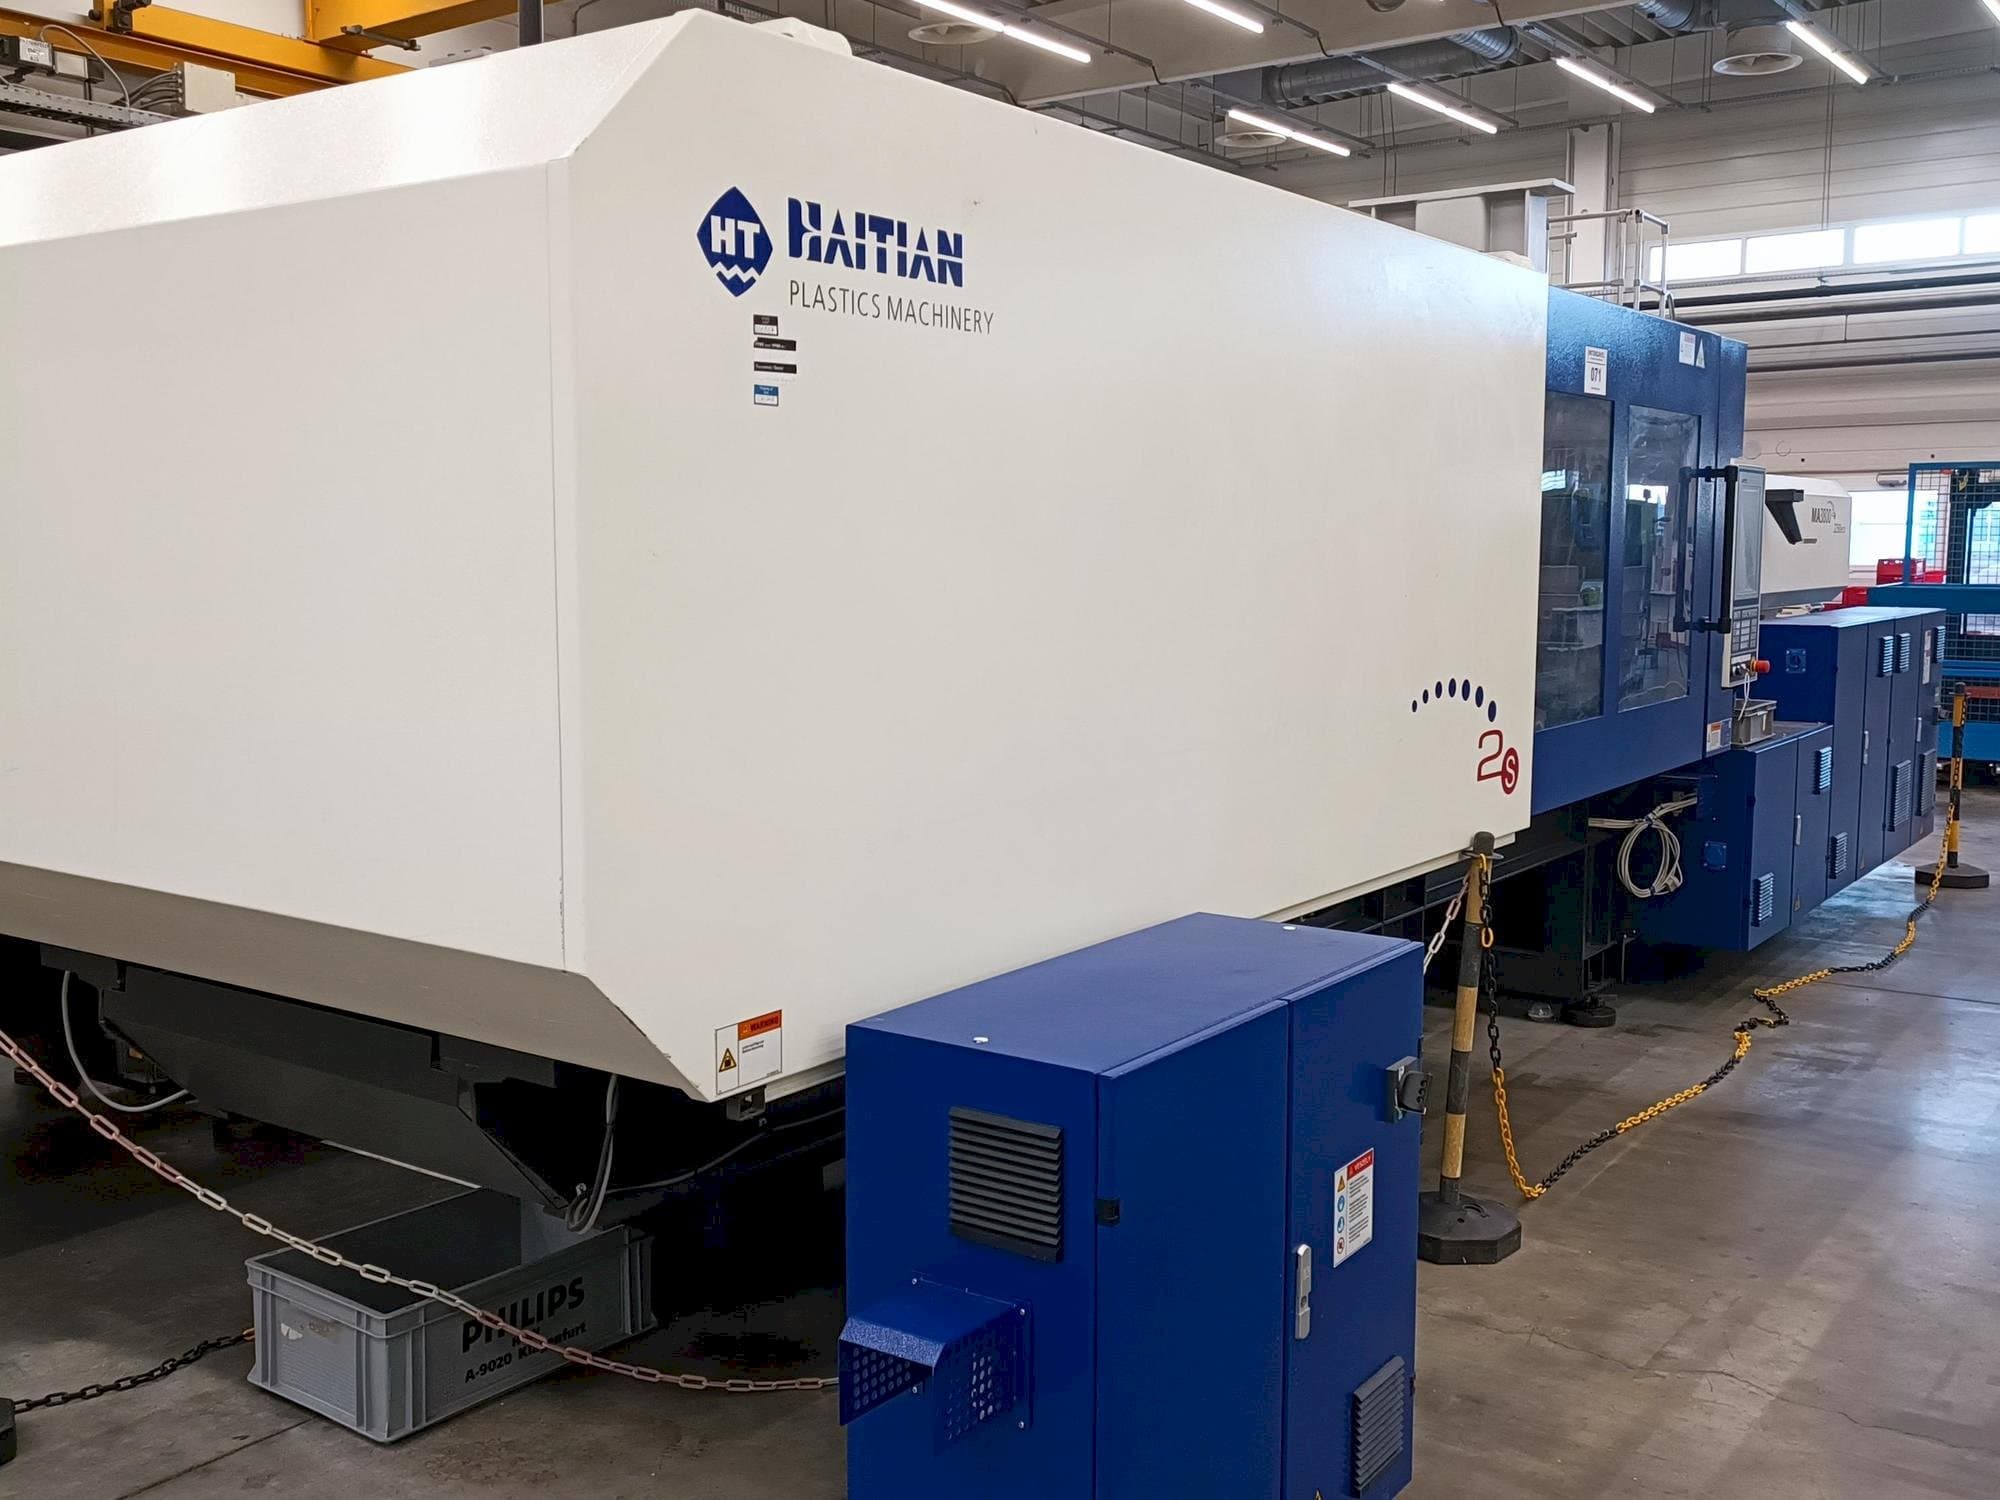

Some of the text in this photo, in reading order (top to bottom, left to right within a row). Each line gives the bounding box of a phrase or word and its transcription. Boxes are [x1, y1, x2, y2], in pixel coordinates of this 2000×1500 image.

[787, 196, 963, 288] HAITIAN
[789, 279, 994, 335] PLASTICS MACHINERY
[1590, 366, 1602, 382] 071
[462, 1276, 585, 1354] PHILIPS
[465, 1352, 513, 1384] A-9020
